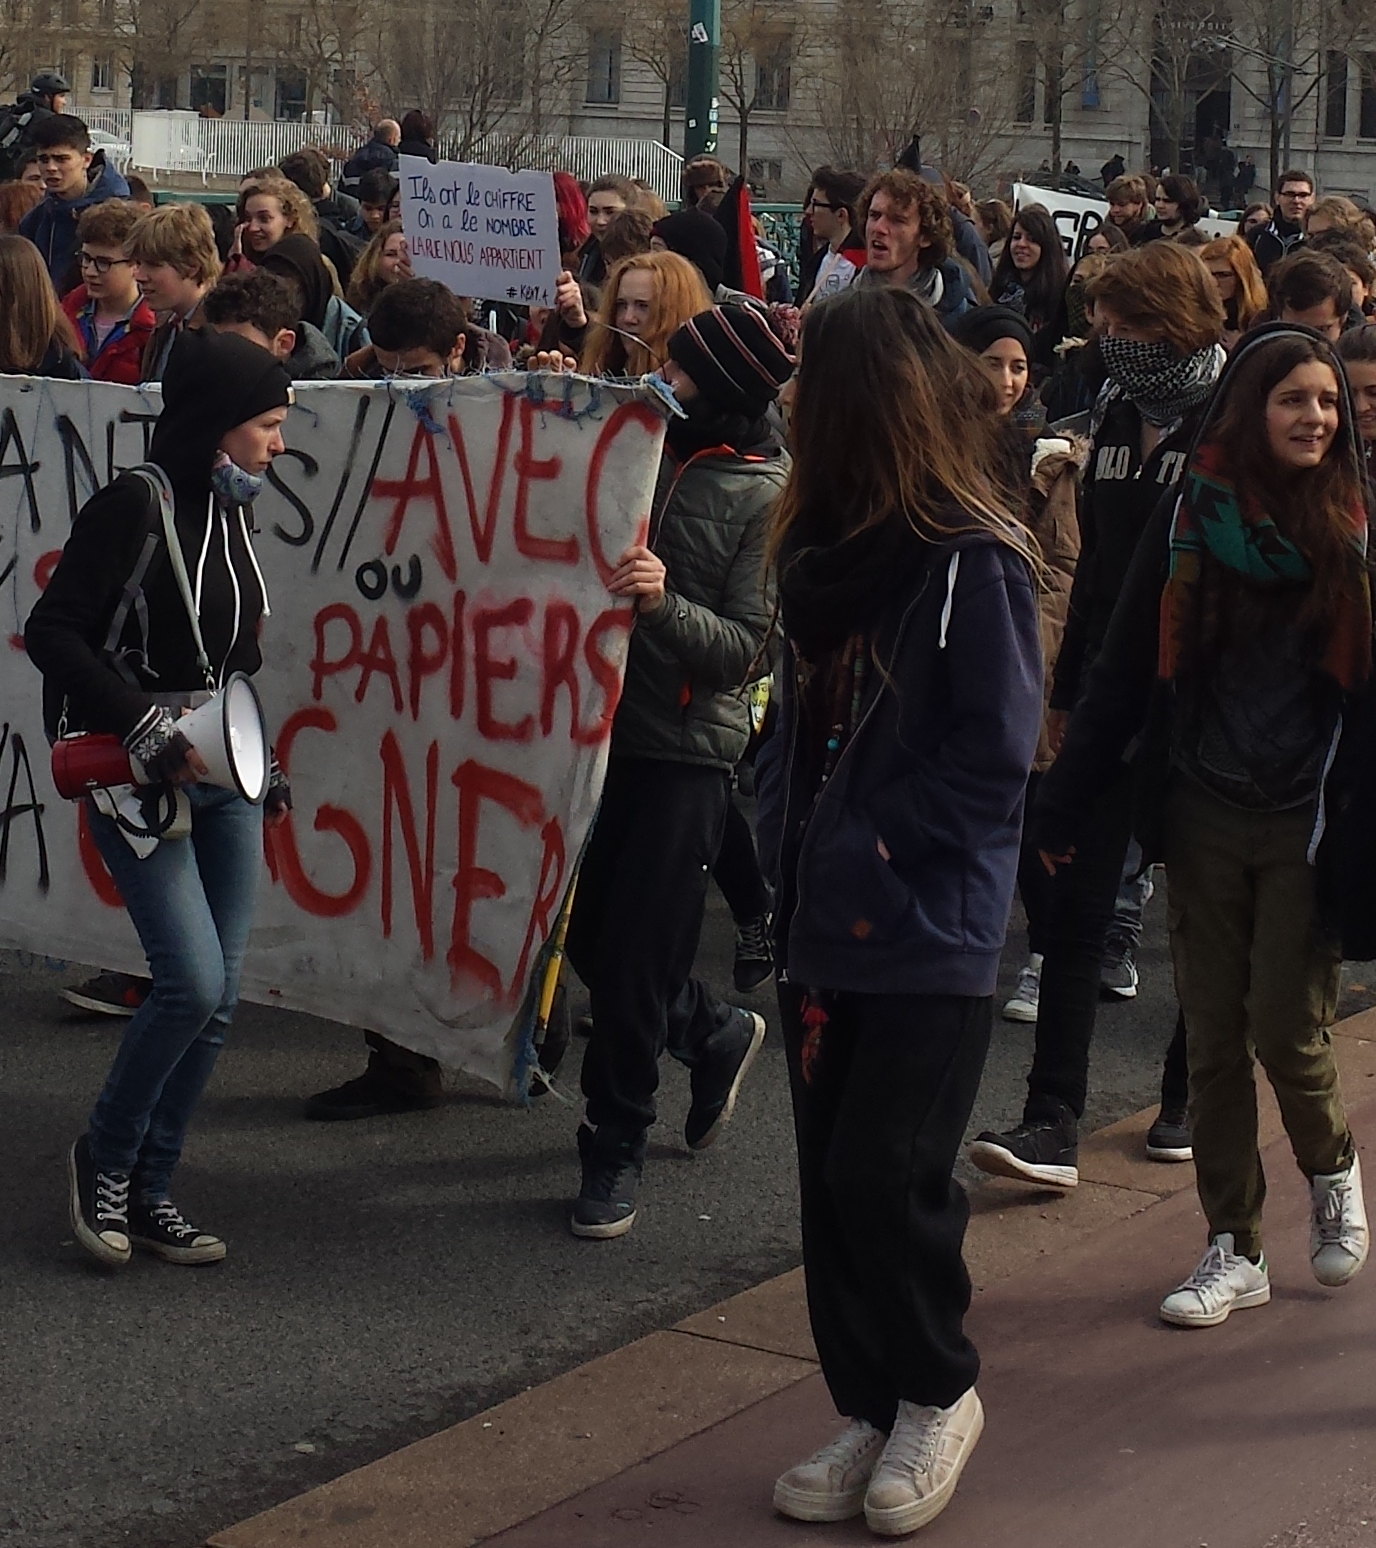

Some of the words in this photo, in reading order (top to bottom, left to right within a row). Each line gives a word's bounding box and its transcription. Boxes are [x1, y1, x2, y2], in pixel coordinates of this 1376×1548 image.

[408, 175, 436, 203] Ils
[466, 181, 480, 206] le
[442, 215, 452, 229] a
[460, 209, 478, 232] le
[486, 217, 537, 237] NOMBRE
[443, 240, 474, 265] NOUS
[355, 553, 424, 601] OU
[309, 588, 640, 746] PAPIERS
